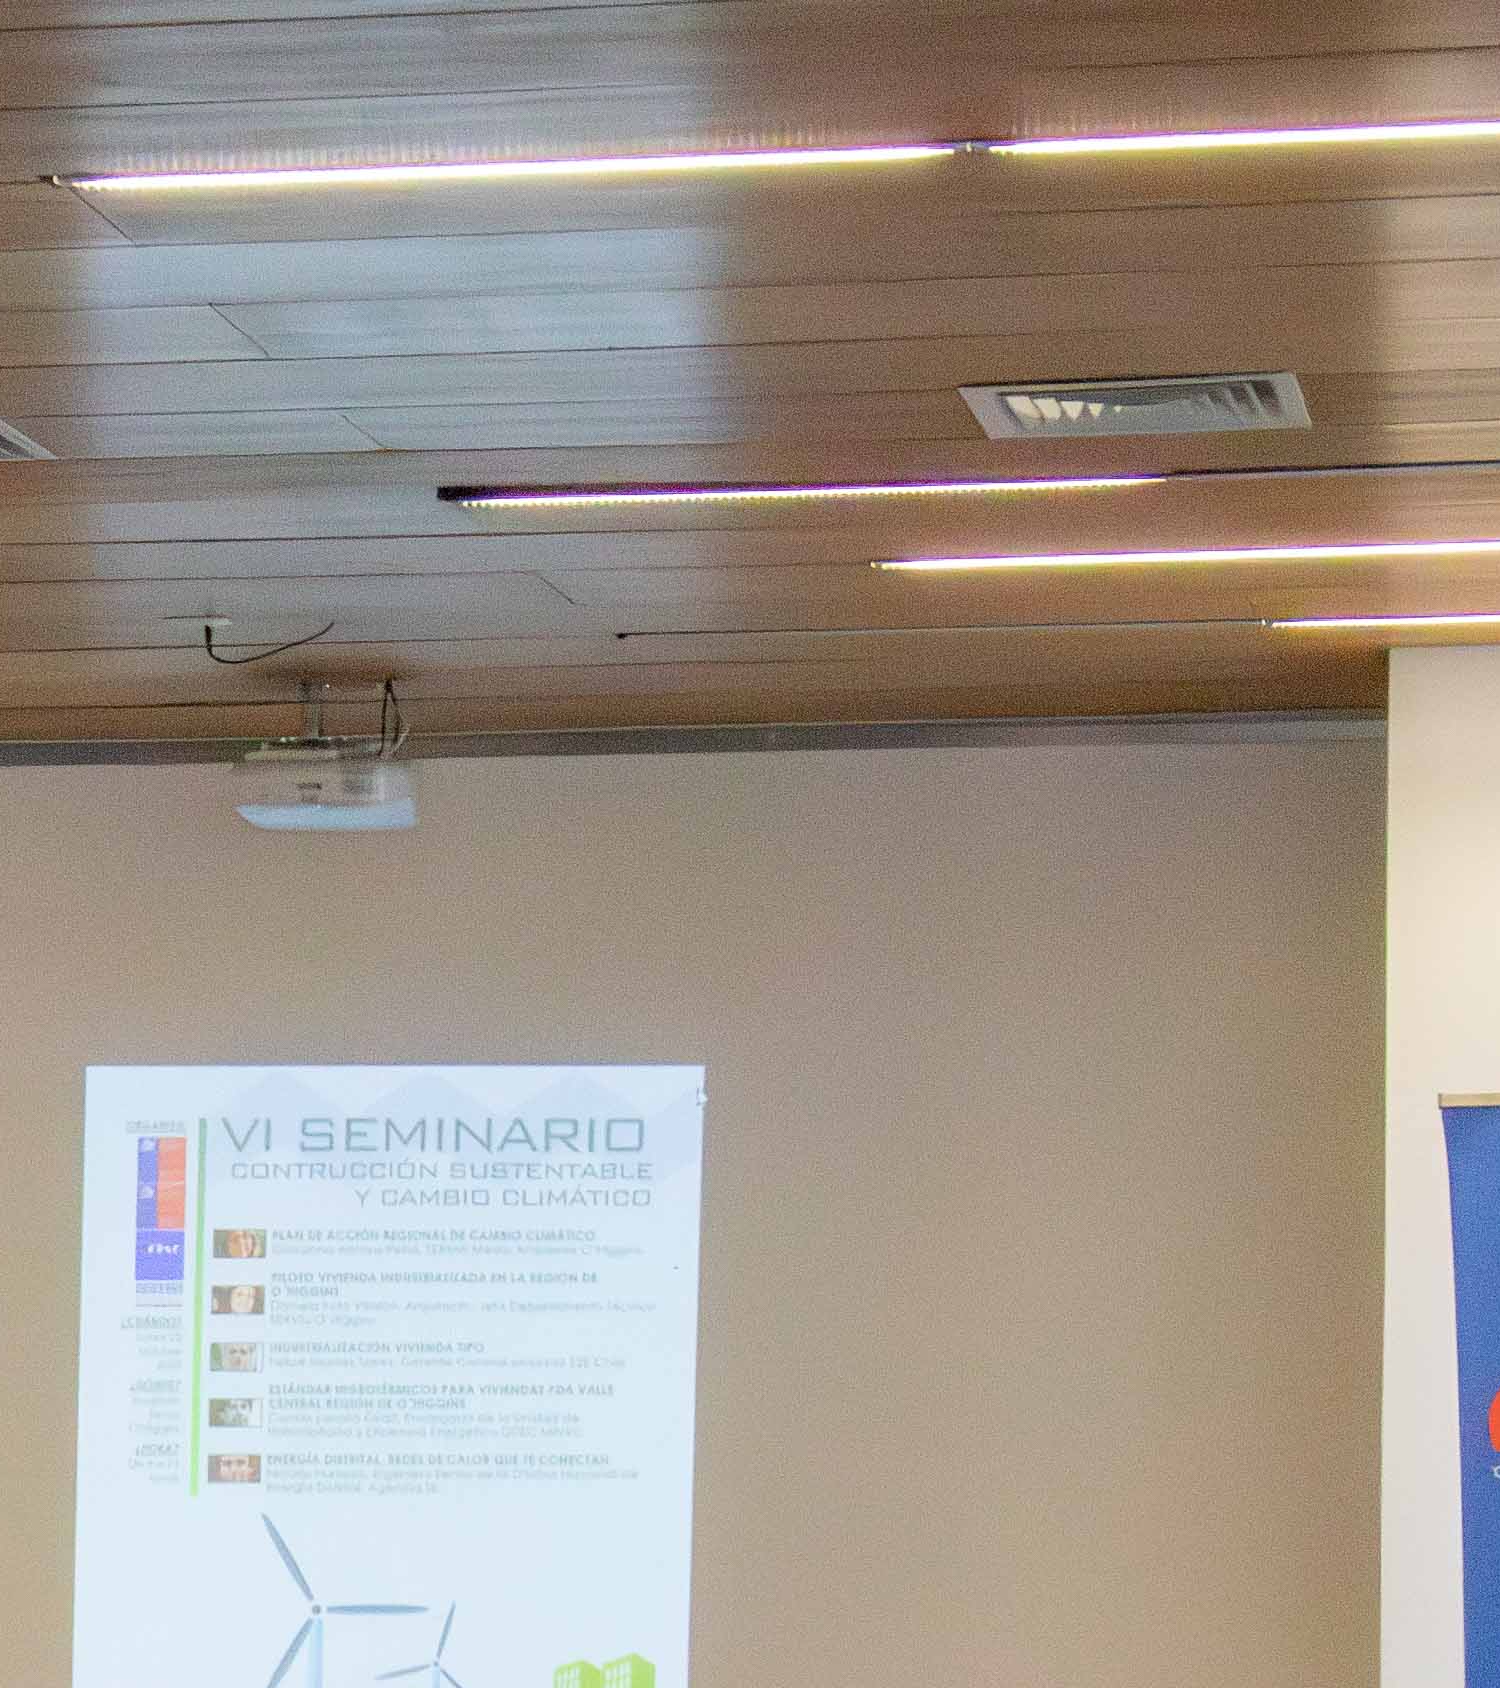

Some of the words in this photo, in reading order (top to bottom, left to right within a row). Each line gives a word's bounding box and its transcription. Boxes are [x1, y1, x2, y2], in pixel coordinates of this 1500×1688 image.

[221, 1117, 272, 1152] VI
[299, 1117, 646, 1153] SEMINARIO
[231, 1158, 438, 1180] CONTRUCCIÓN
[450, 1162, 653, 1180] SUSTENTABLE
[355, 1189, 369, 1208] Y
[381, 1189, 489, 1208] CAMBIO
[502, 1184, 652, 1208] CLIMÁTICO
